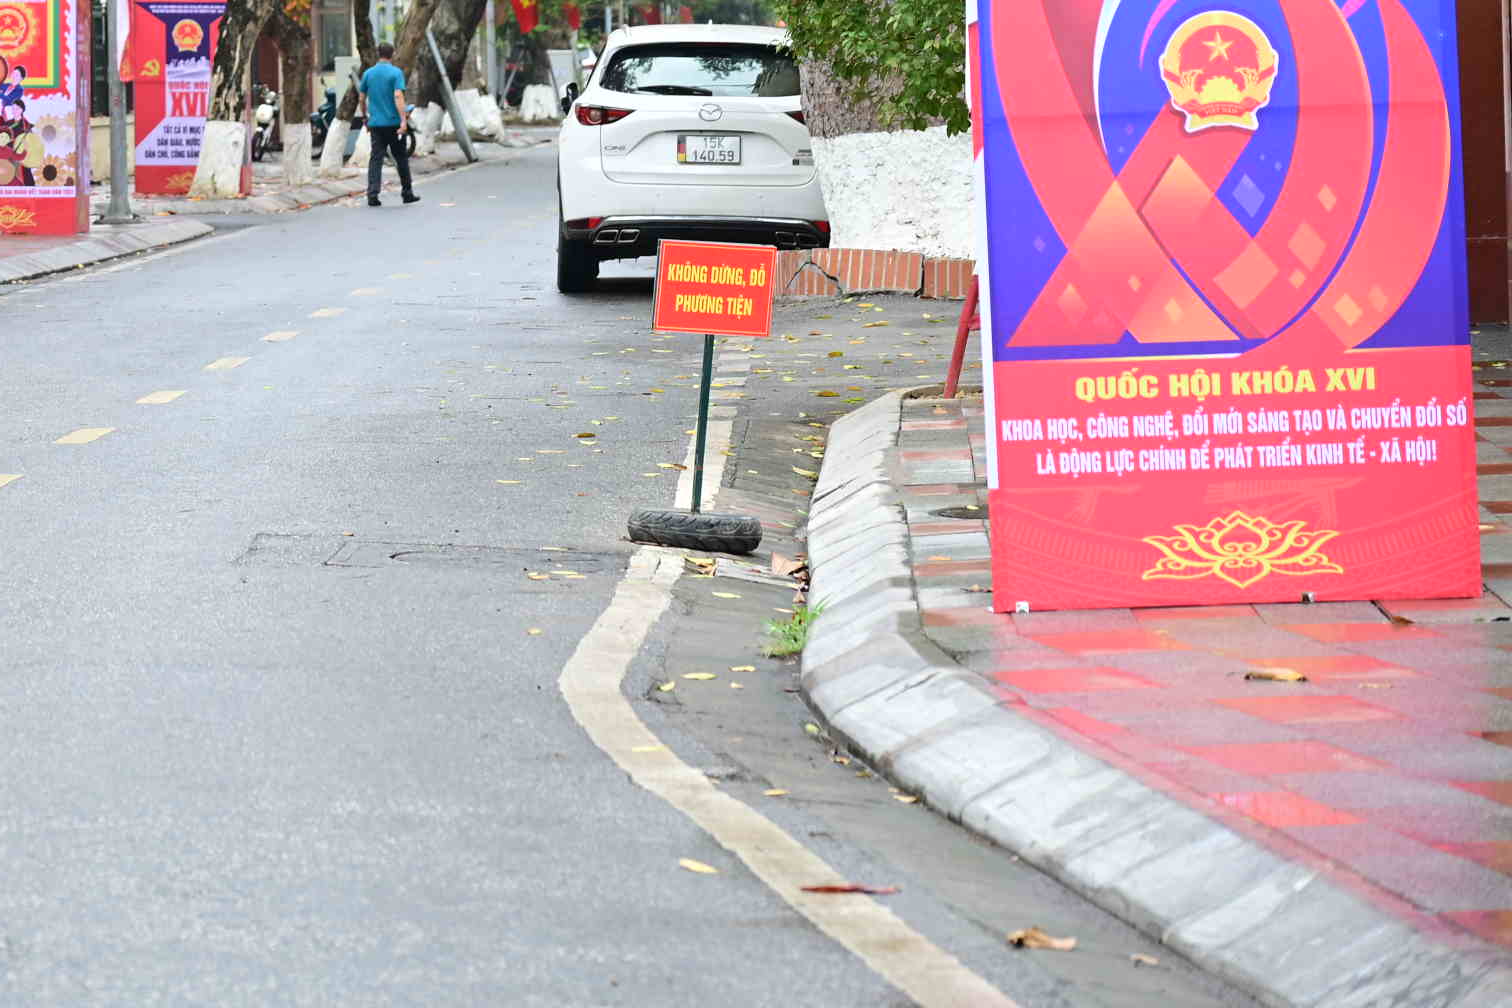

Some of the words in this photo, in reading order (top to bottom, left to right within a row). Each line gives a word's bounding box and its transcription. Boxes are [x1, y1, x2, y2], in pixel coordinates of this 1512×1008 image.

[171, 92, 206, 118] XVI
[704, 136, 725, 149] 15K
[668, 260, 708, 283] KHÔNG
[749, 263, 766, 287] ĐỖ
[675, 293, 723, 314] PHƯƠNG
[727, 294, 753, 320] TIỆN
[1075, 367, 1159, 403] QUỐC
[1168, 368, 1221, 401] HỘI
[1231, 364, 1317, 395] KHÓA
[1325, 366, 1376, 392] XVI
[1001, 418, 1044, 442] KHOA
[1047, 417, 1083, 444] HỌC,
[1086, 412, 1129, 439] CÔNG
[1133, 410, 1179, 441] NGHỆ,
[1182, 405, 1209, 437] ĐỔI
[1212, 406, 1243, 435] MỚI
[1247, 407, 1290, 434] SÁNG
[1293, 409, 1322, 436] TẠO
[1326, 403, 1347, 431] VÀ
[1350, 397, 1412, 430] CHUYỂN
[1415, 396, 1442, 428] ĐỔI
[1446, 396, 1468, 427] SỐ
[1036, 448, 1056, 475] LÀ
[1059, 447, 1102, 478] ĐỘNG
[1105, 448, 1135, 478] LỰC
[1138, 444, 1186, 472] CHÍNH
[1190, 439, 1210, 470] ĐỂ
[1214, 442, 1253, 469] PHÁT
[1256, 436, 1302, 467] TRIỂN
[1305, 443, 1344, 466] KINH
[1347, 434, 1365, 464] TẾ
[1380, 437, 1402, 463] XÃ
[1405, 436, 1437, 466] HỘI!
